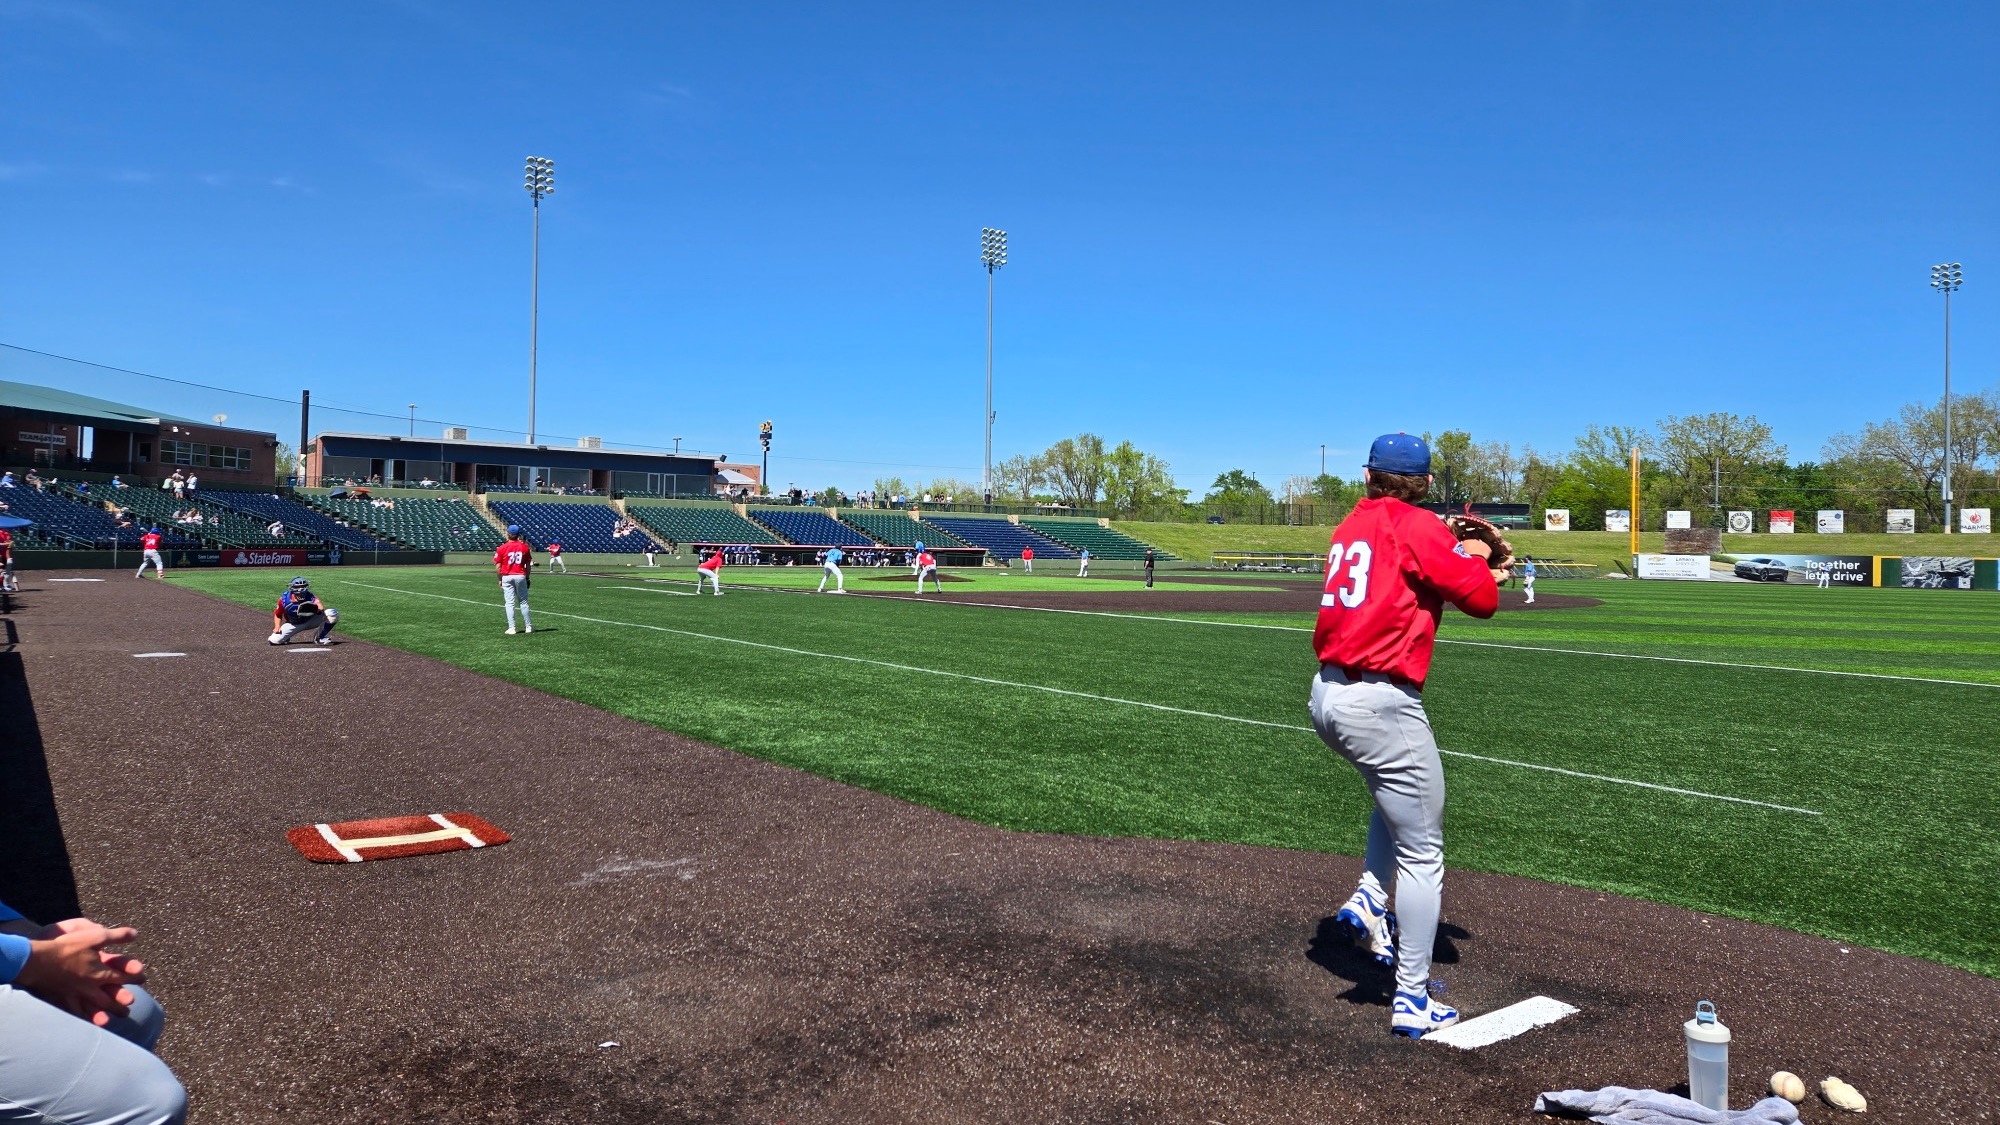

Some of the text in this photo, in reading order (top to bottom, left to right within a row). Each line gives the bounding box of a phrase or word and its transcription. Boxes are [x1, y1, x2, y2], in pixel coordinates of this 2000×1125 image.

[1321, 540, 1373, 609] 23
[1805, 571, 1864, 581] let' drive
